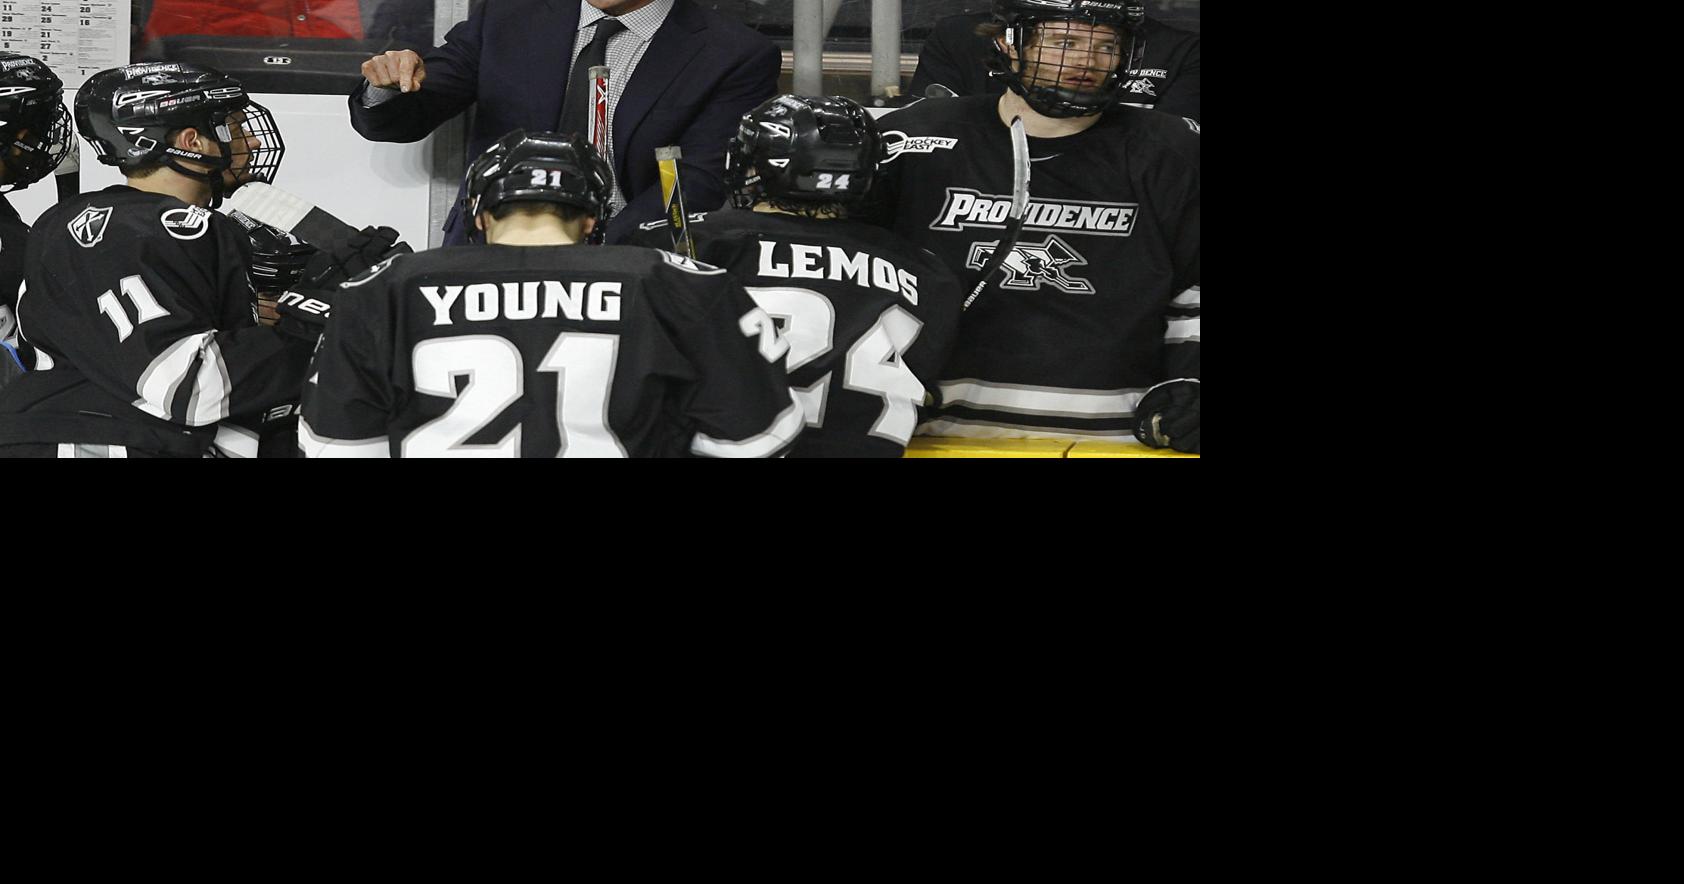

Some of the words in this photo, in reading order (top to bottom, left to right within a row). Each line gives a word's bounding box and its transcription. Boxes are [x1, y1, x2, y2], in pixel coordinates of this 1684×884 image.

[125, 64, 181, 80] PROVIDENCE
[166, 147, 203, 160] BAUER
[904, 138, 952, 147] HOCKEY
[530, 169, 562, 187] 21
[816, 173, 851, 190] 24
[940, 193, 1134, 232] PROIDENCE
[757, 240, 919, 306] LEMOS
[97, 274, 171, 343] 11
[419, 280, 622, 326] YOUNG
[743, 286, 925, 448] 24
[401, 331, 629, 458] 21
